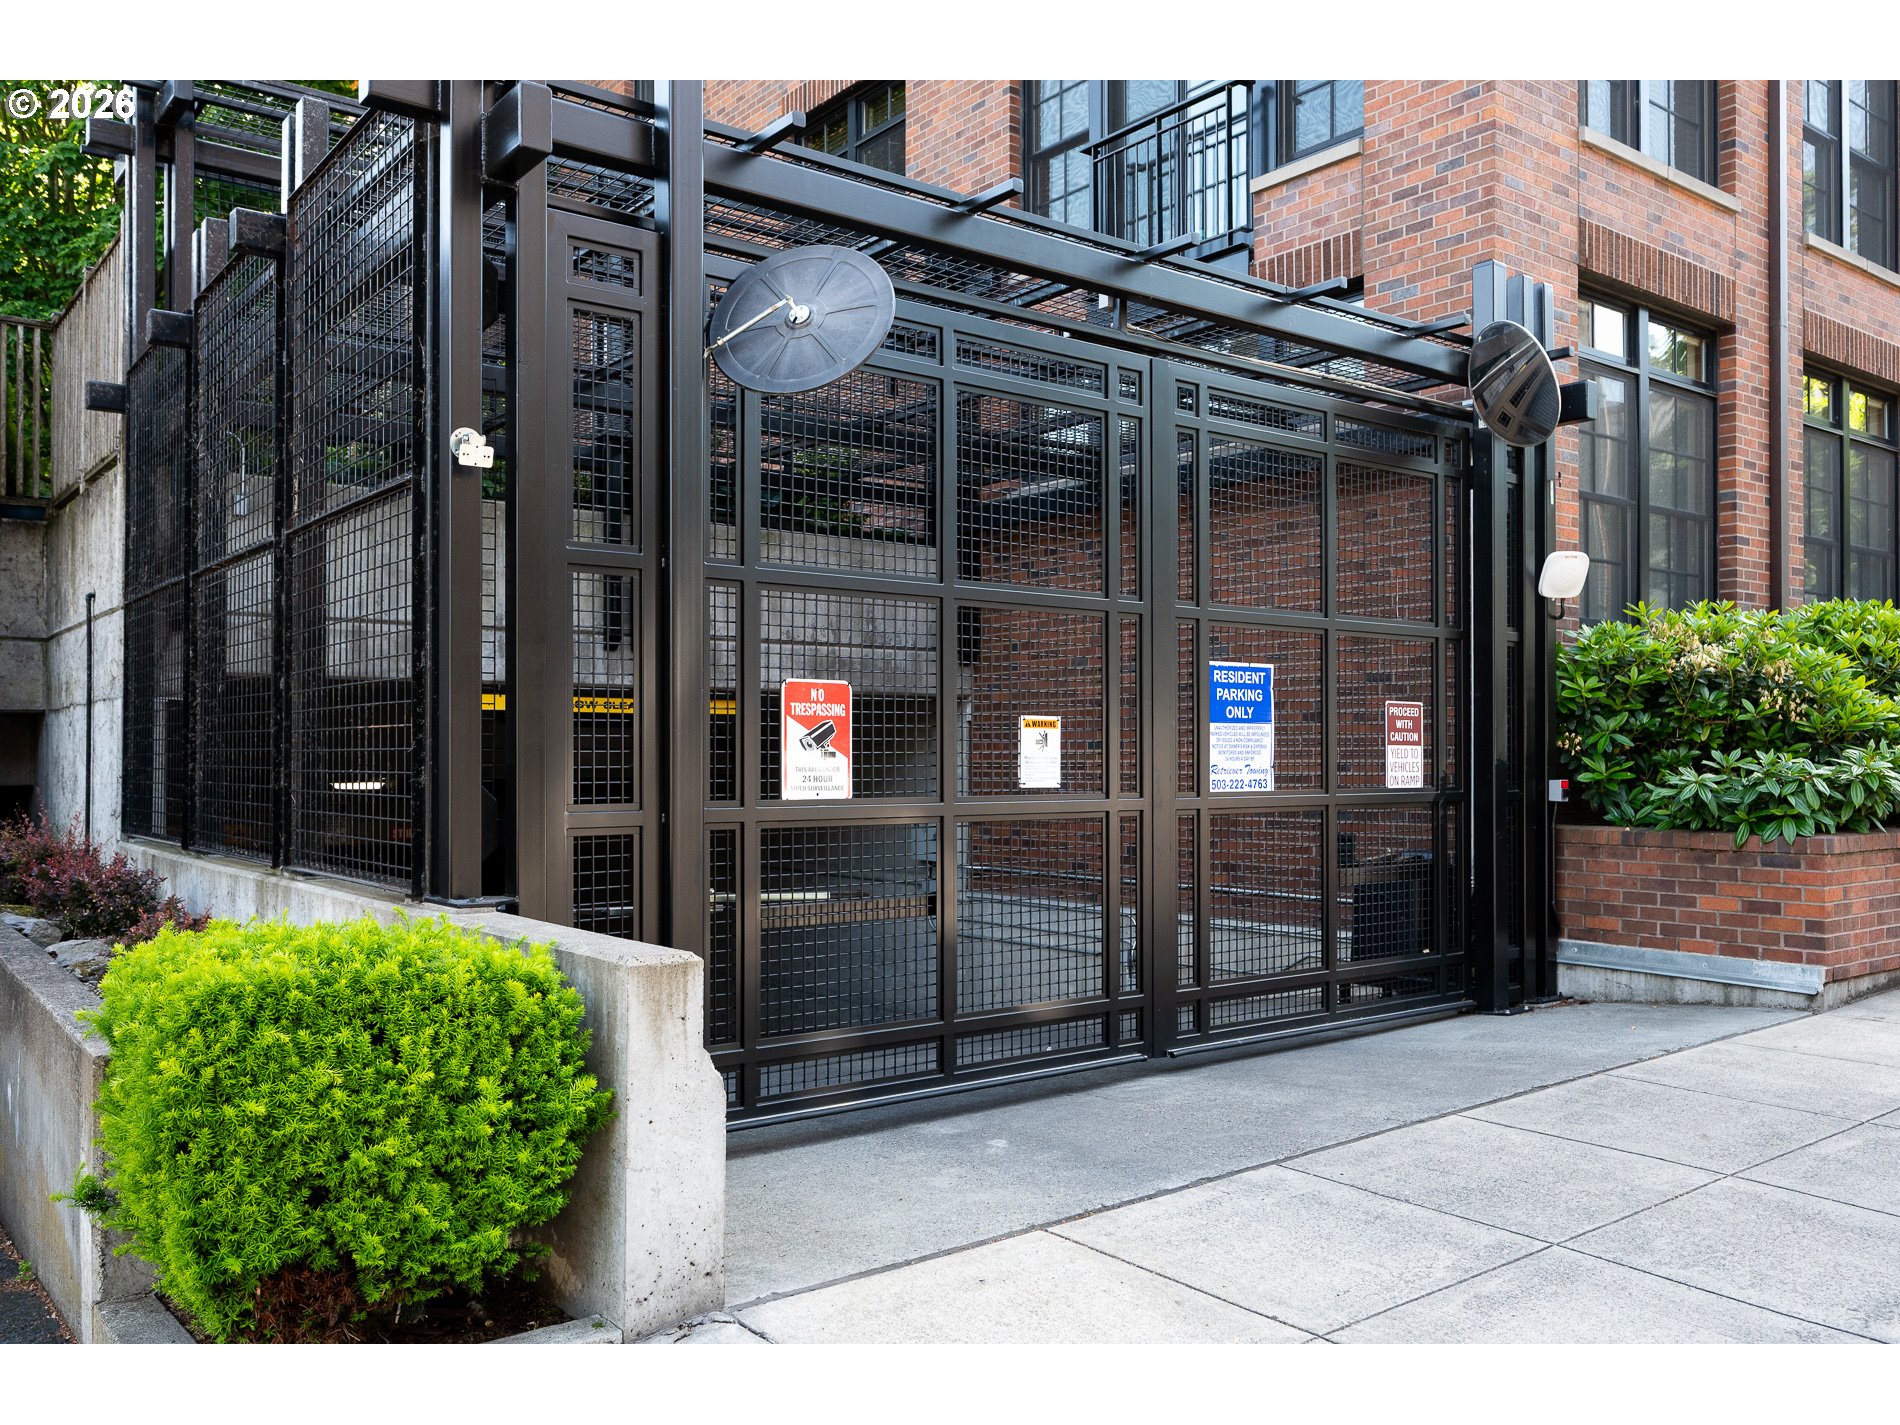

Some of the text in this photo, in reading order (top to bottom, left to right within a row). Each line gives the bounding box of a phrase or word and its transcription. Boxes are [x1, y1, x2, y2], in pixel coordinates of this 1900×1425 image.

[1213, 669, 1266, 684] RESIDENT
[810, 688, 825, 702] NO
[1216, 687, 1263, 702] PARKING
[573, 700, 600, 709] OW
[790, 702, 846, 717] TRESPASSING
[1225, 705, 1255, 719] ONLY
[1389, 706, 1419, 717] PROCEED
[1031, 720, 1057, 728] WARNING
[1395, 719, 1413, 729] WITH
[1390, 732, 1418, 742] CAUTION
[1390, 748, 1419, 759] YIELD TO
[1210, 764, 1269, 777] Retriever Towing
[1389, 761, 1420, 773] VEHICLES
[802, 775, 833, 784] 24 HOUR
[1211, 778, 1268, 790] 503-222-4763
[1389, 774, 1420, 787] ON RAMP
